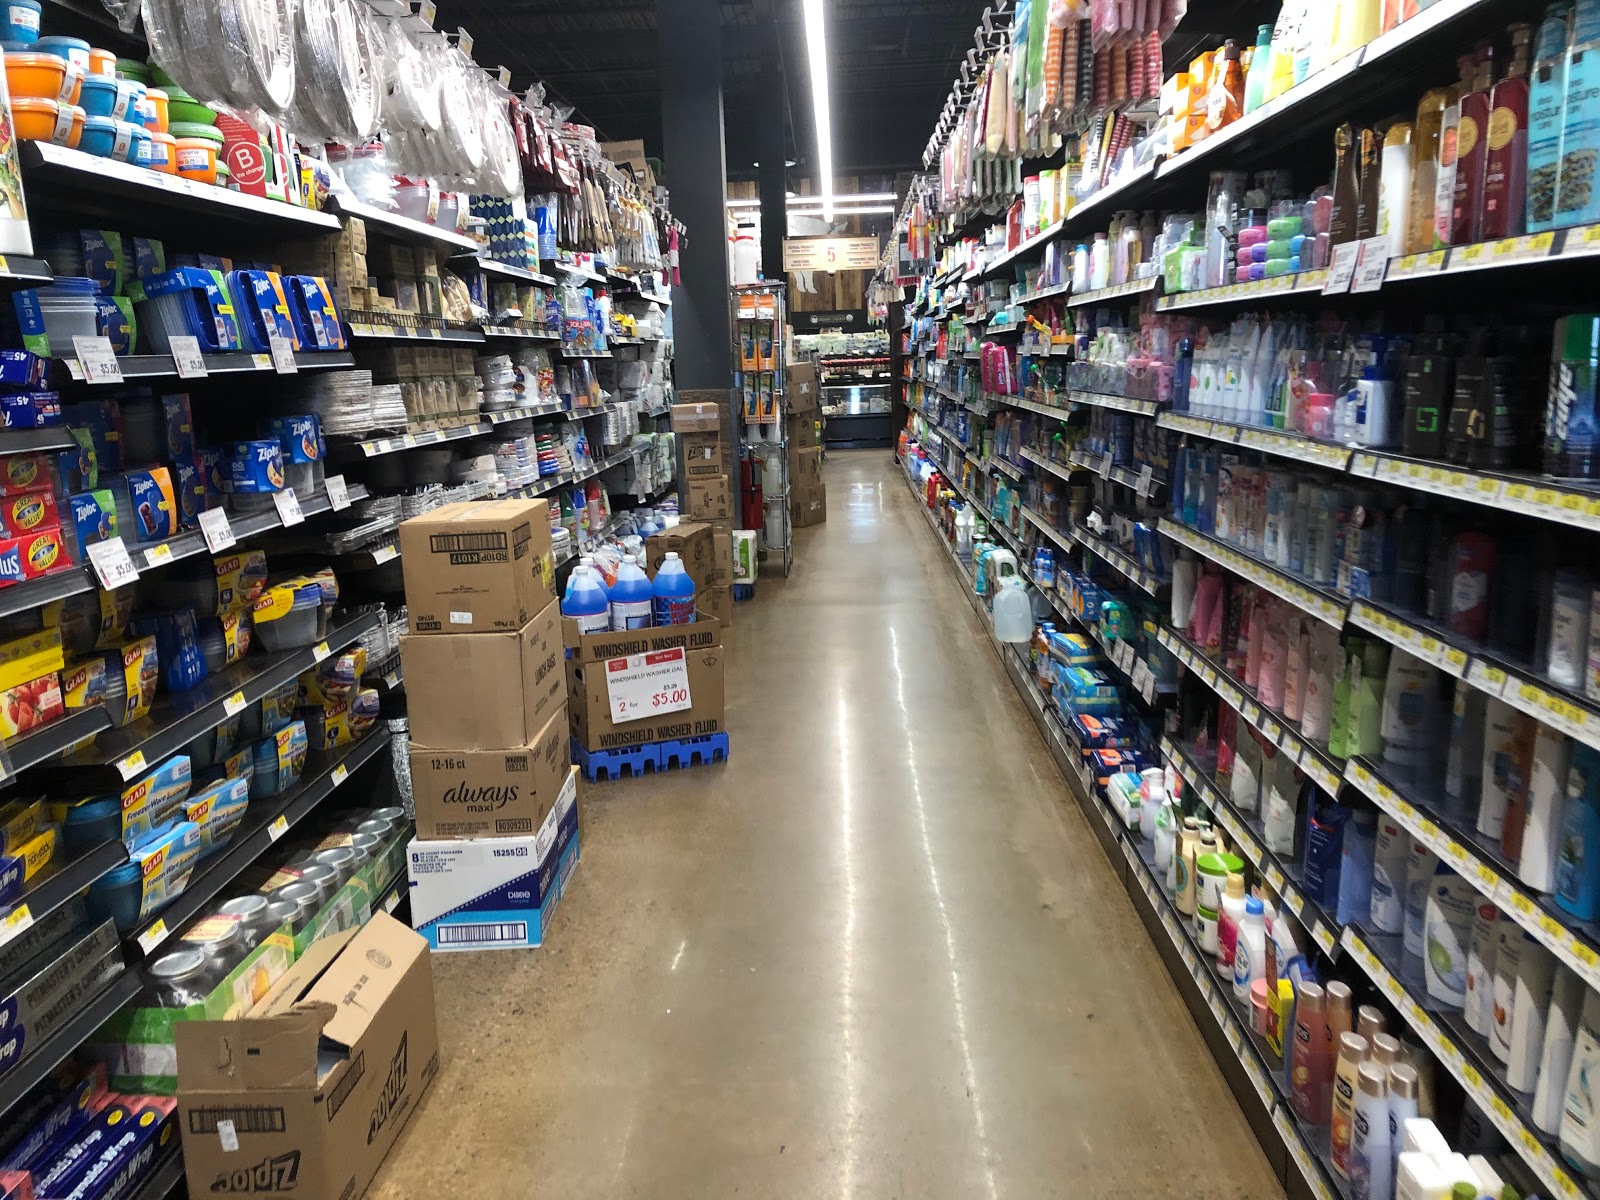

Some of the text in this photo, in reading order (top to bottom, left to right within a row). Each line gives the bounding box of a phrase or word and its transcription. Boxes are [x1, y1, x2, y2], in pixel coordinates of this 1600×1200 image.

[235, 149, 254, 170] B
[236, 171, 246, 179] the
[85, 240, 104, 251] Ziploc
[827, 250, 836, 262] 5
[205, 284, 218, 296] Ziploc
[253, 279, 270, 295] Ziploc
[302, 282, 318, 298] Ziploc
[99, 304, 118, 317] Ziploc
[14, 352, 27, 361] 45
[100, 362, 120, 375] $5.00
[17, 396, 29, 406] 45
[134, 479, 154, 496] Ziploc
[16, 495, 35, 508] GREAT
[23, 511, 42, 527] VALUE!
[75, 502, 97, 522] Ziploc
[32, 535, 50, 552] GREAT
[0, 553, 20, 577] lus
[38, 552, 56, 569] VALUE!
[452, 553, 479, 562] K1017
[115, 562, 136, 576] $5.00
[216, 560, 239, 575] GLAD
[253, 598, 273, 611] GLAD
[223, 614, 237, 630] GLAD
[592, 632, 713, 659] WINDSHIELD WASHER FLUID
[124, 646, 142, 667] GLAD
[65, 669, 87, 693] GLAD
[610, 665, 684, 685] WINDSHIELD WASHER GAL
[652, 688, 688, 708] $5.00
[325, 702, 347, 718] GLAD
[619, 701, 627, 713] 2
[277, 732, 290, 748] GLAD
[599, 719, 718, 748] WINDSHIELD WASHER FLUID
[431, 759, 455, 770] 12-16
[123, 786, 145, 808] GLAD
[443, 781, 520, 809] always
[188, 802, 208, 822] GLAD
[467, 803, 494, 813] maxi
[411, 853, 420, 863] 8
[493, 849, 515, 857] 15255
[143, 852, 163, 876] GLAD
[367, 1029, 408, 1145] Ziploc
[44, 1104, 72, 1140] Wrap
[65, 1130, 103, 1160] Wrap
[99, 1131, 136, 1162] Wrap
[127, 1143, 154, 1179] Wrap
[210, 1150, 301, 1194] Ziploc
